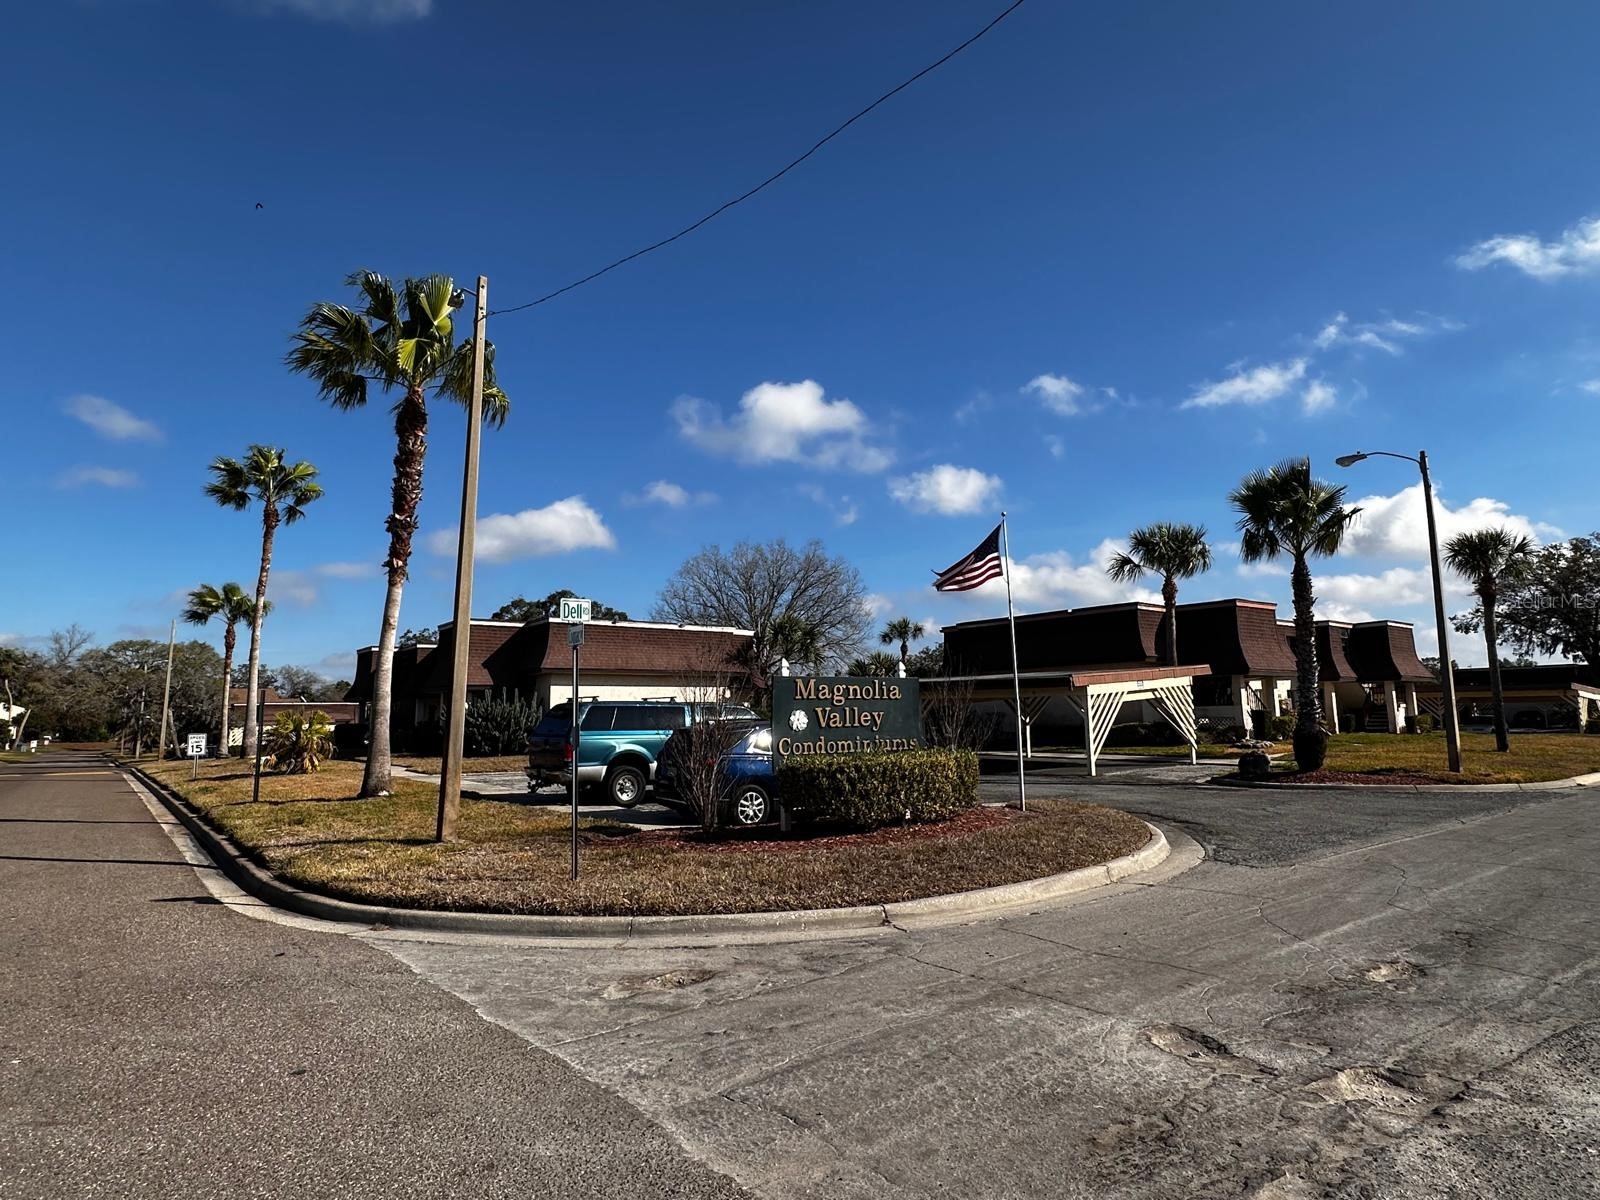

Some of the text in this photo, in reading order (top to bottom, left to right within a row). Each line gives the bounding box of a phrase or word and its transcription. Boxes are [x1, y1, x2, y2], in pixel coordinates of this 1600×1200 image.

[563, 602, 582, 619] Dell
[795, 678, 902, 706] Magnolia
[815, 706, 885, 731] Valley
[190, 744, 203, 754] 15
